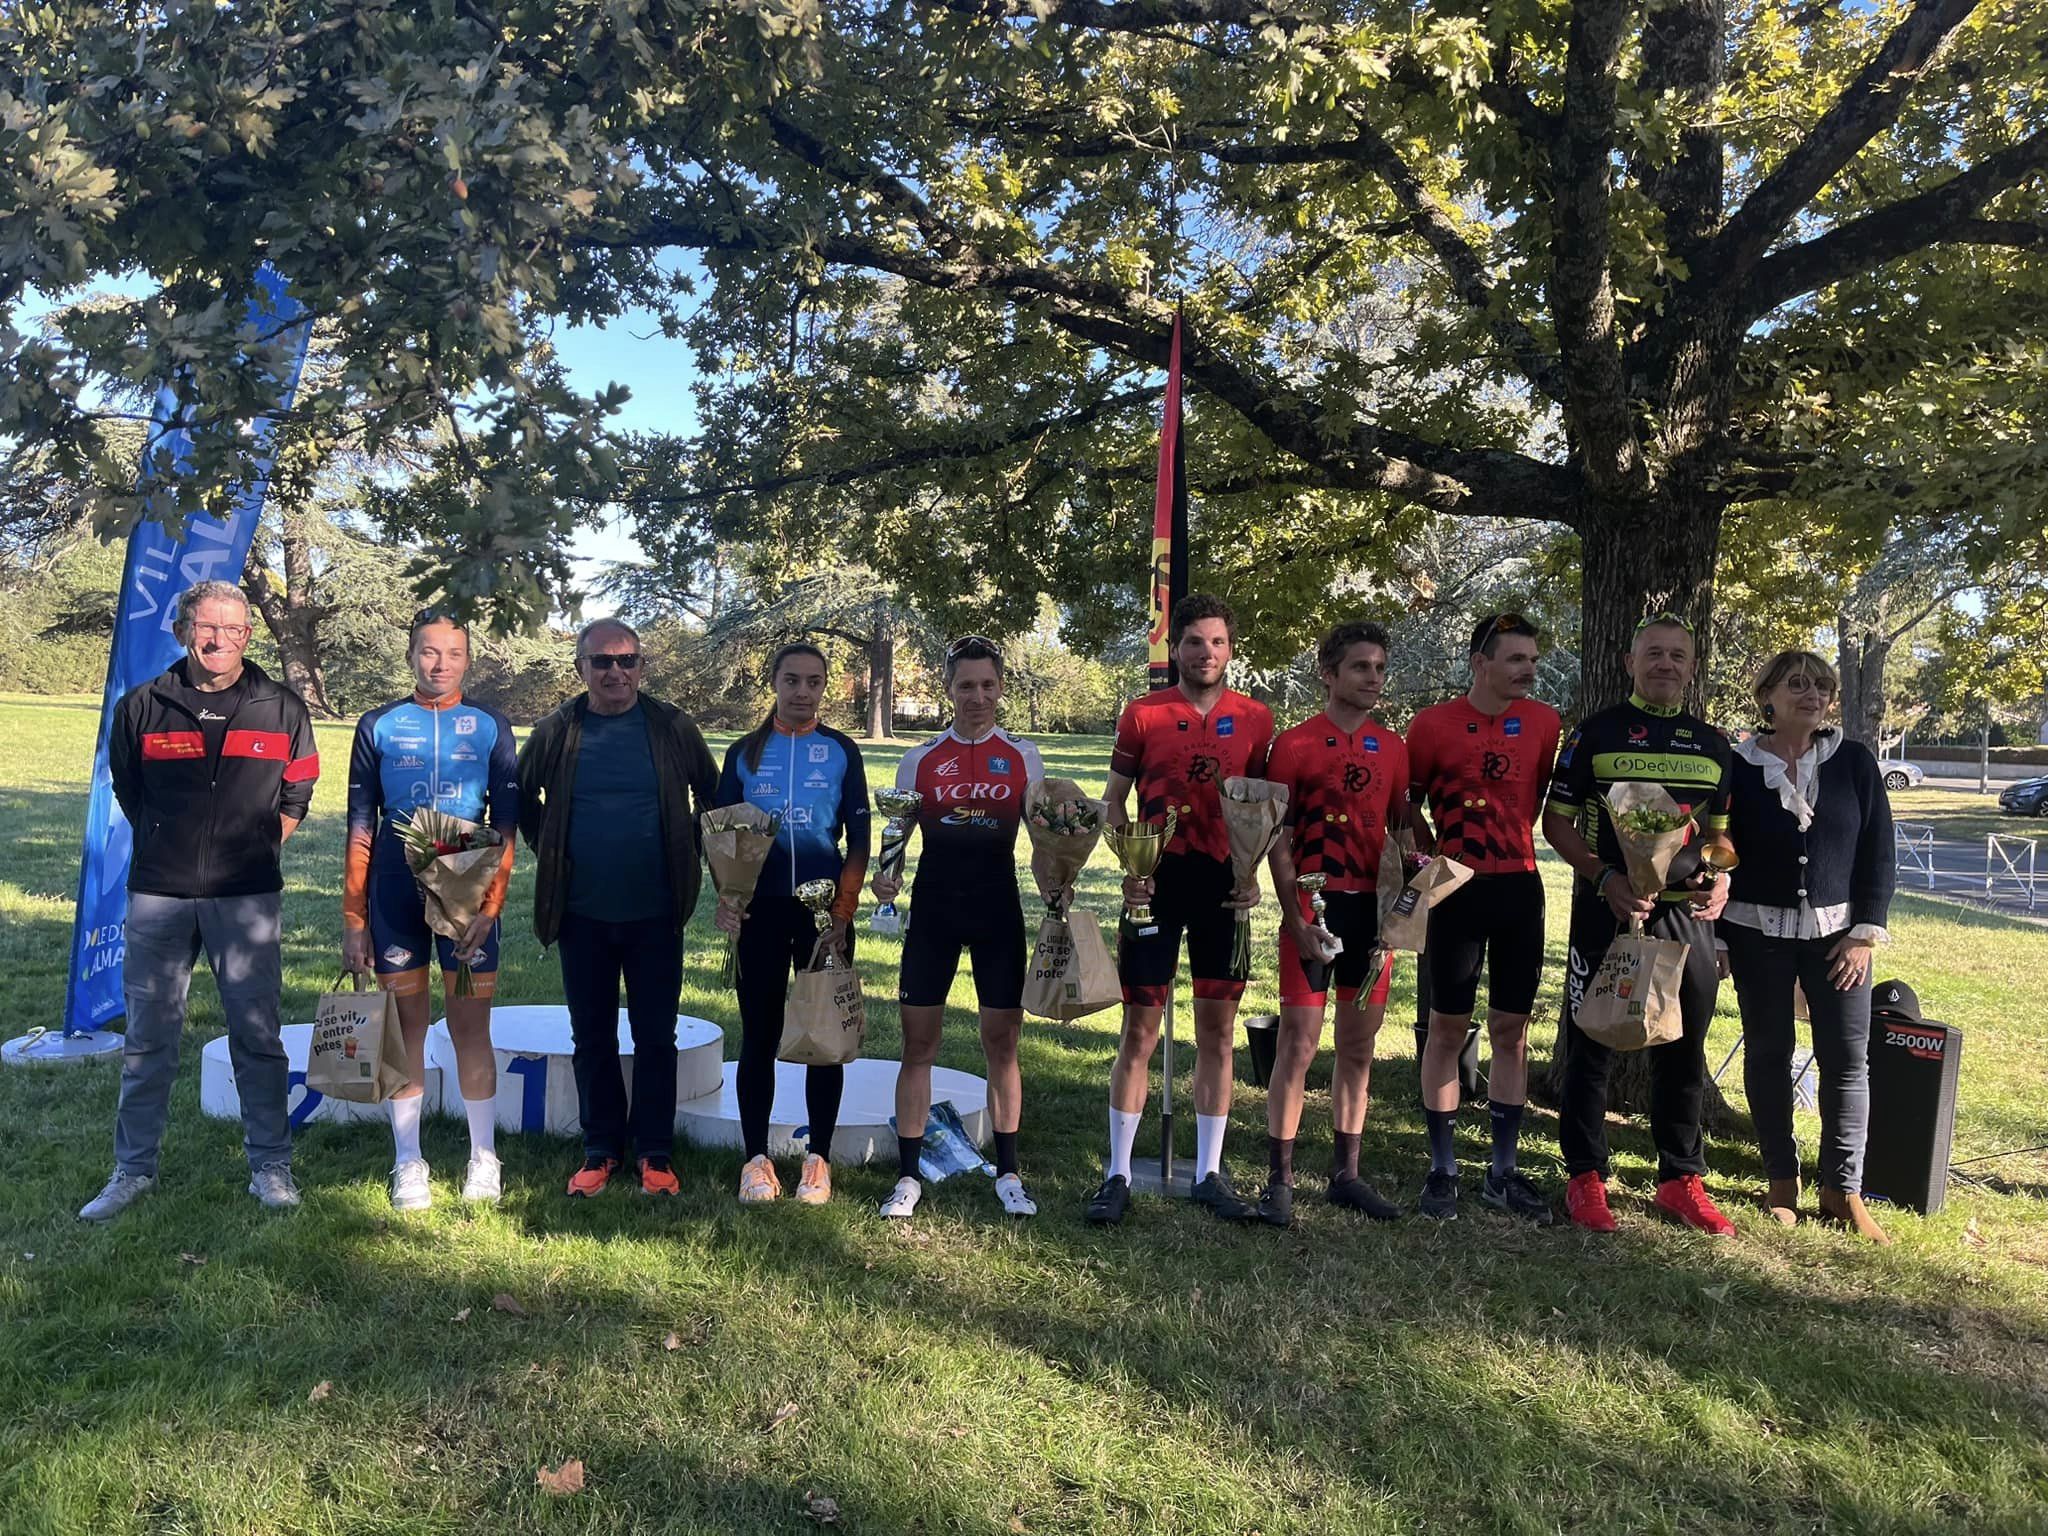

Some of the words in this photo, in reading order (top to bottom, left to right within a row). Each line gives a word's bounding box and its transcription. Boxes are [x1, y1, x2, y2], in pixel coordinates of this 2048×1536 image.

[933, 782, 1011, 802] VCRO
[952, 806, 986, 822] Sun
[323, 1016, 338, 1027] se
[340, 1010, 358, 1023] vit
[322, 1025, 354, 1040] entre
[1885, 1031, 1944, 1052] 2500W
[506, 1056, 547, 1135] 1
